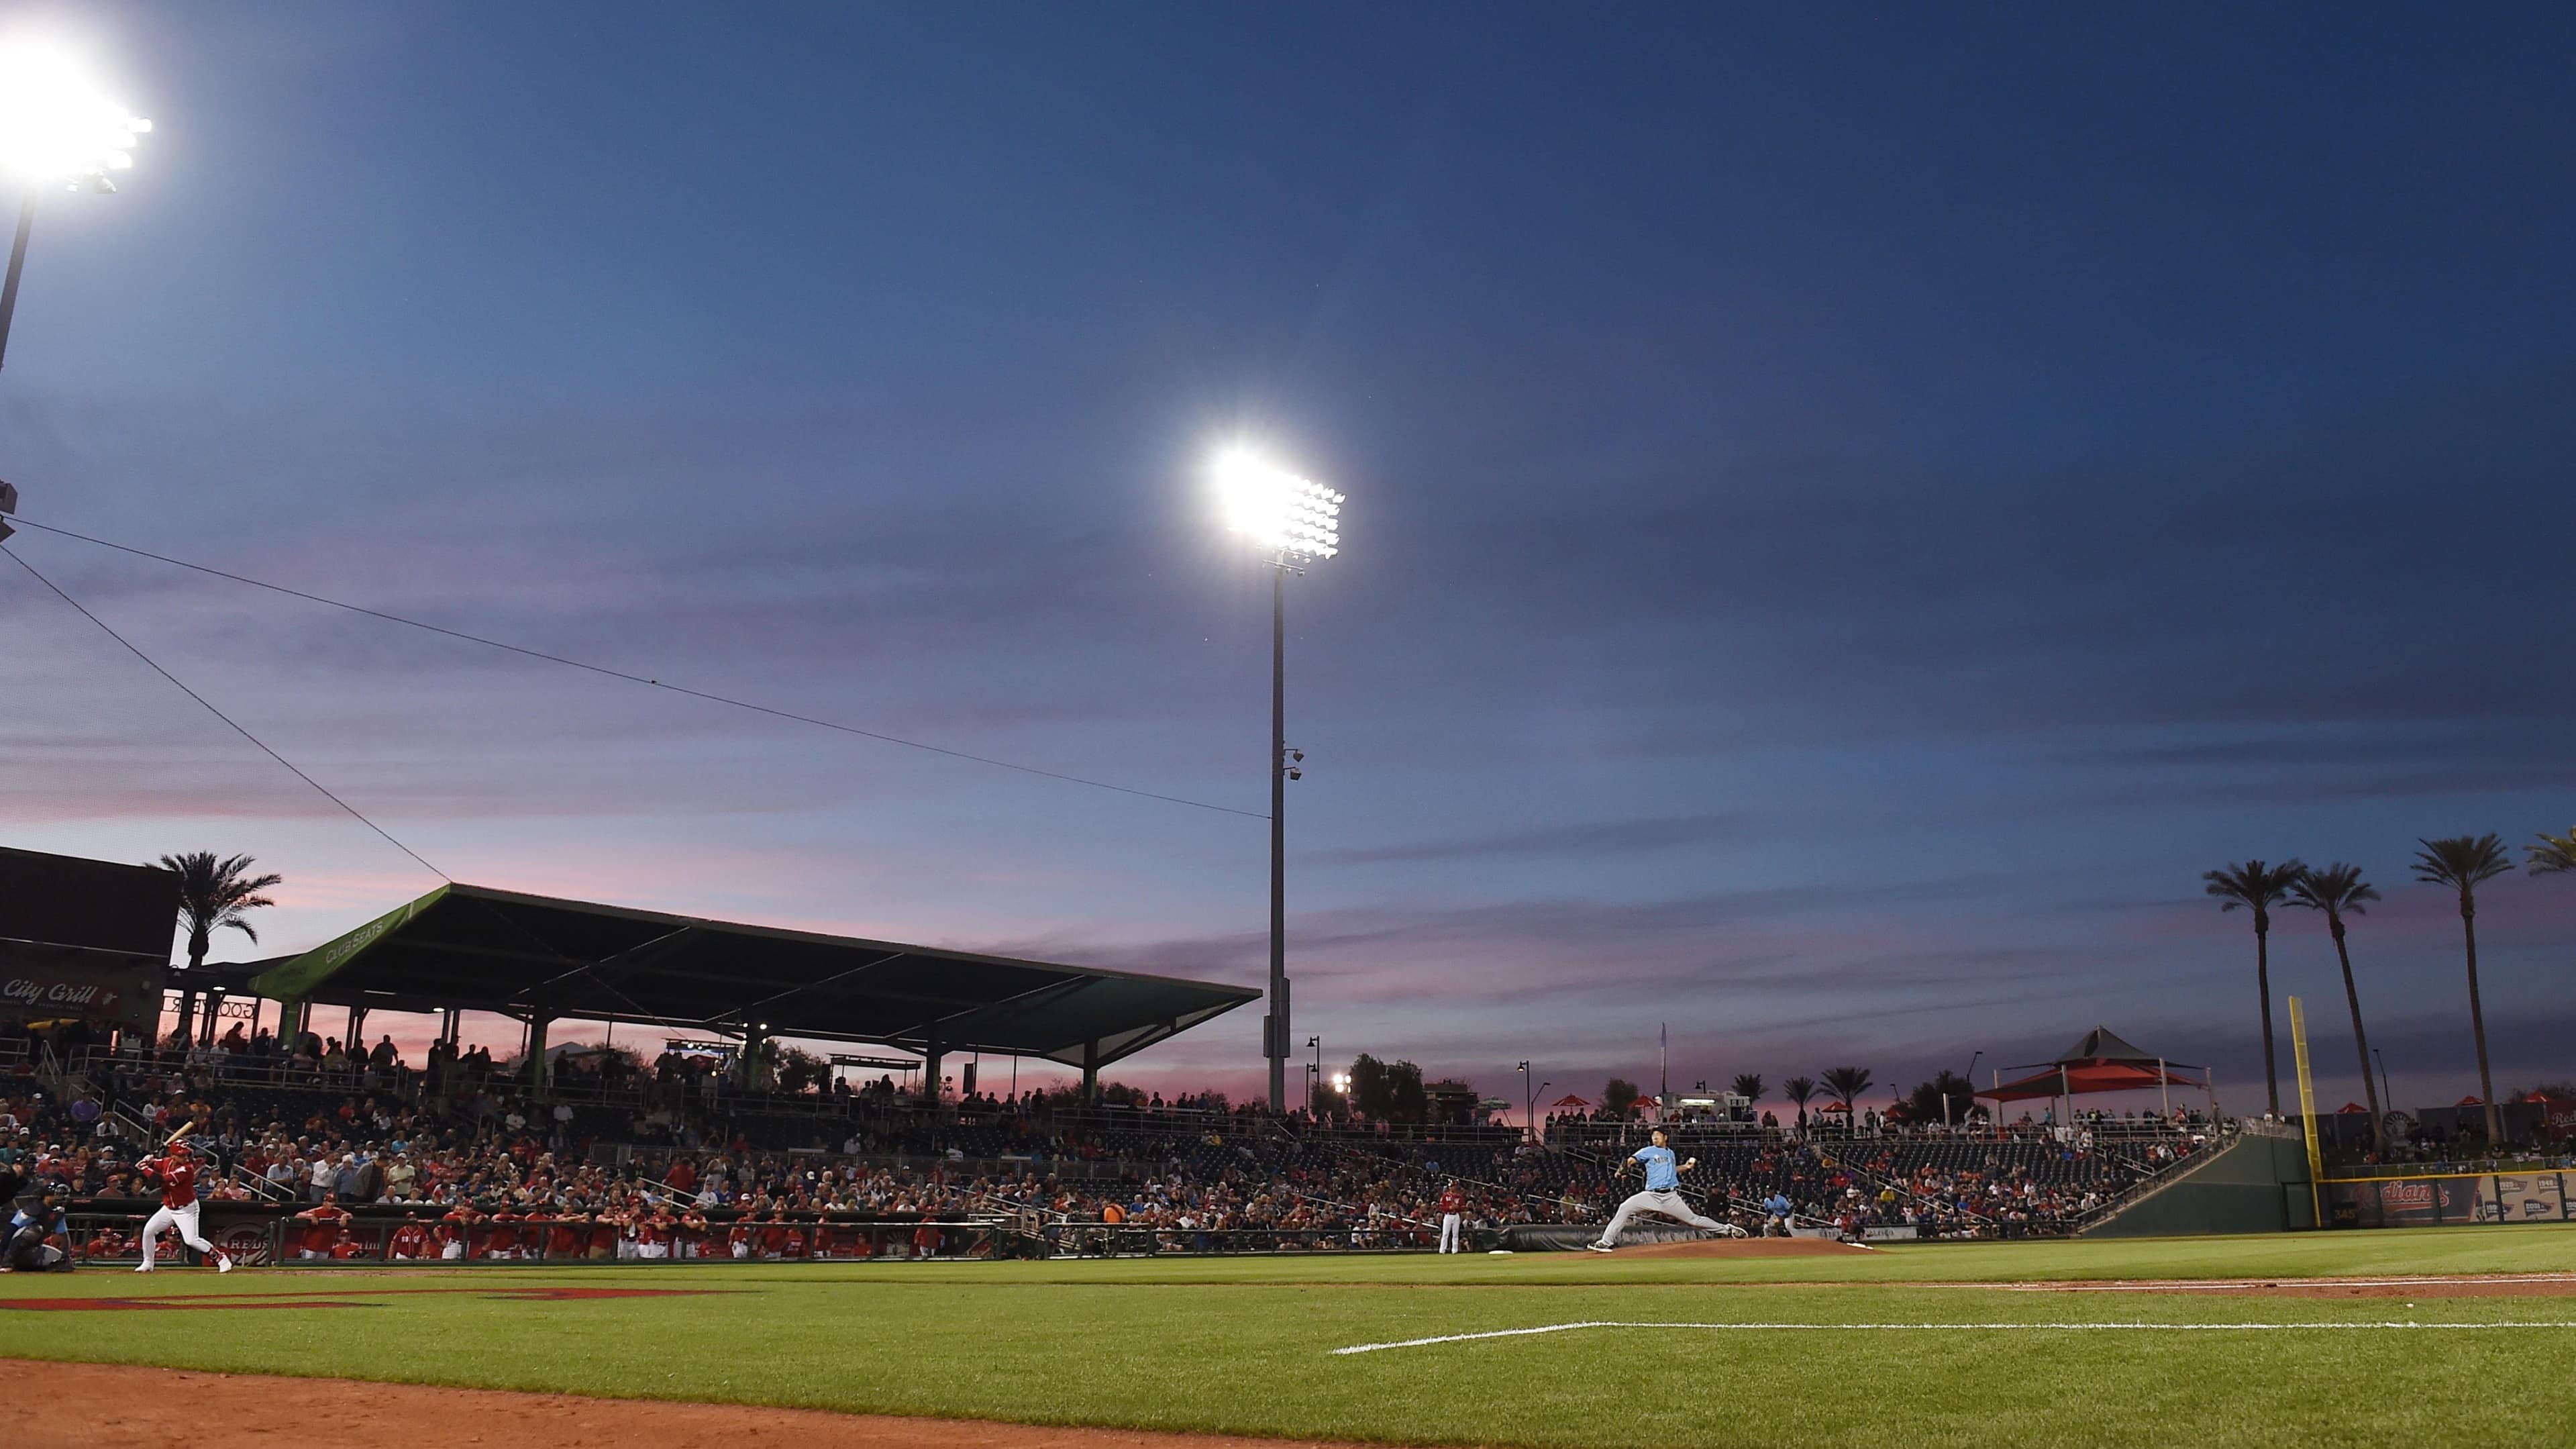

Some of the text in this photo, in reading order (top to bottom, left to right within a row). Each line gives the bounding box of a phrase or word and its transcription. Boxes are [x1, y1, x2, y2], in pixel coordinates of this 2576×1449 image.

[326, 921, 384, 964] CLUB SEATS
[3, 979, 99, 1005] City Grill
[2334, 1209, 2357, 1220] 345
[229, 1239, 268, 1250] REDS
